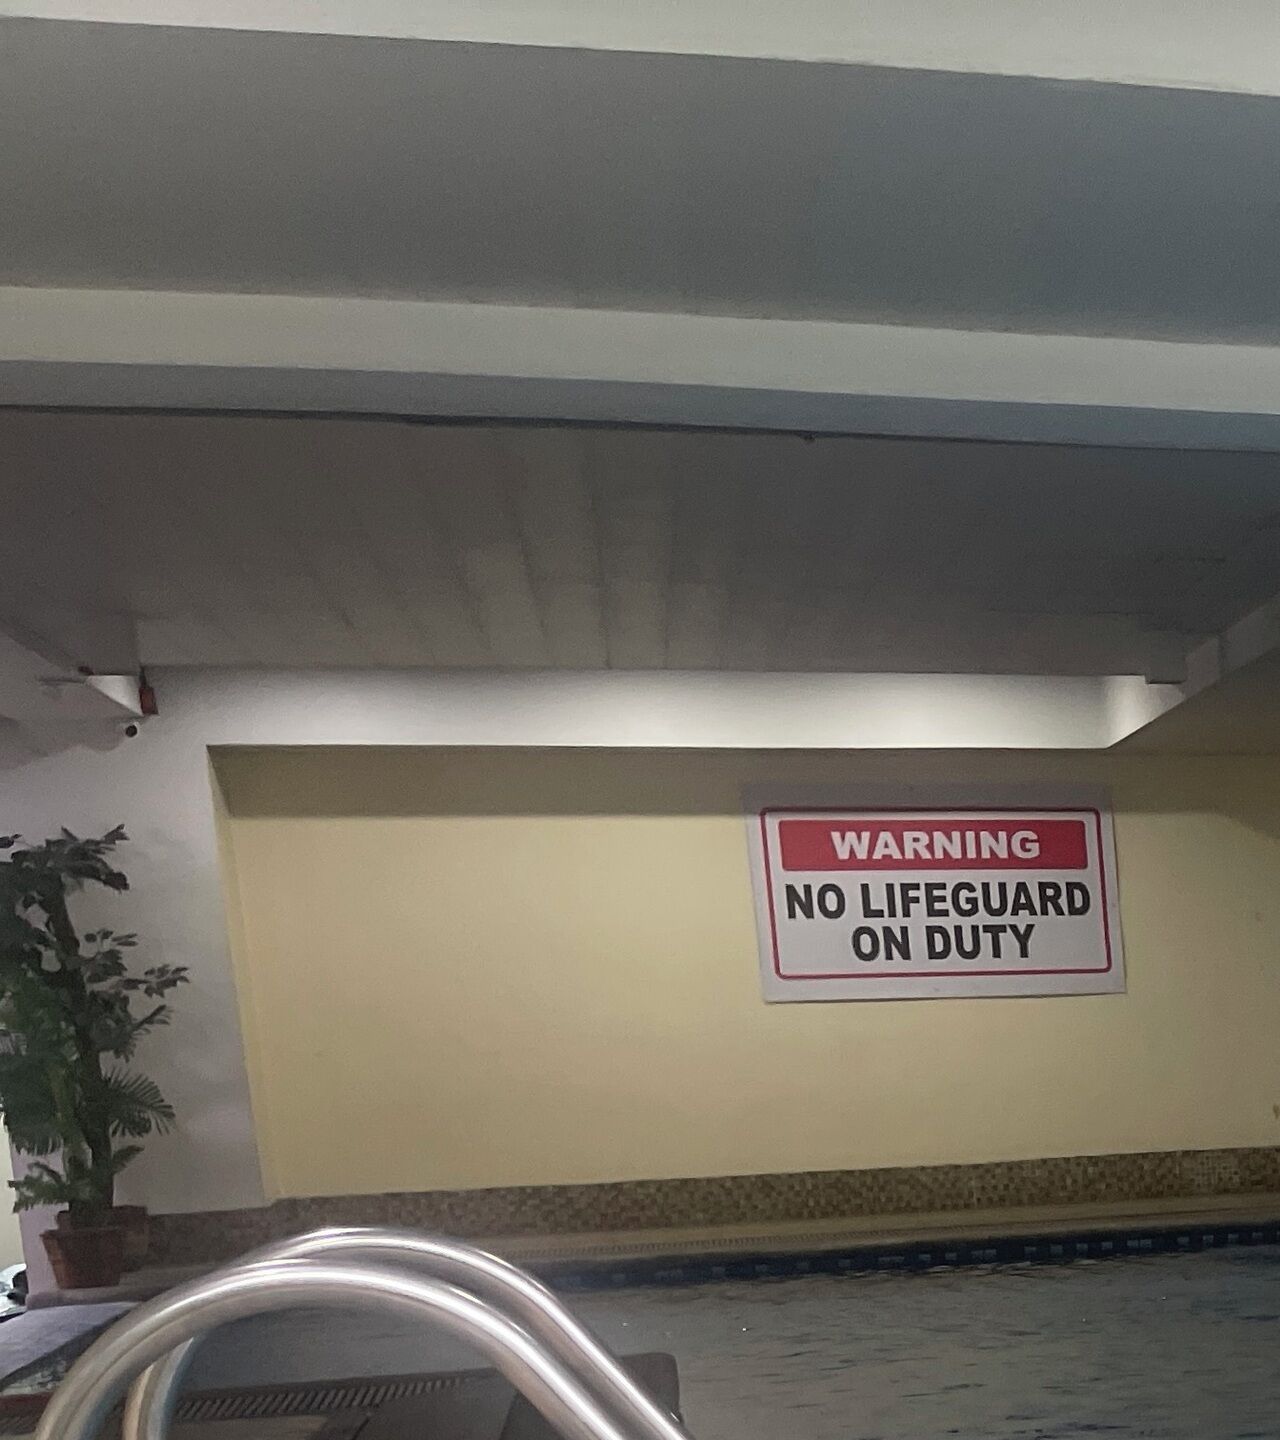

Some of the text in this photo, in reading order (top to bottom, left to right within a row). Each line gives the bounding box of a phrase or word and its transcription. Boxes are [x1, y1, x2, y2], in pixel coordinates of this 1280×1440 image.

[831, 831, 1040, 860] WARNING
[785, 882, 1090, 919] NO LIFEGUARD
[852, 924, 1035, 961] ON DUTY
